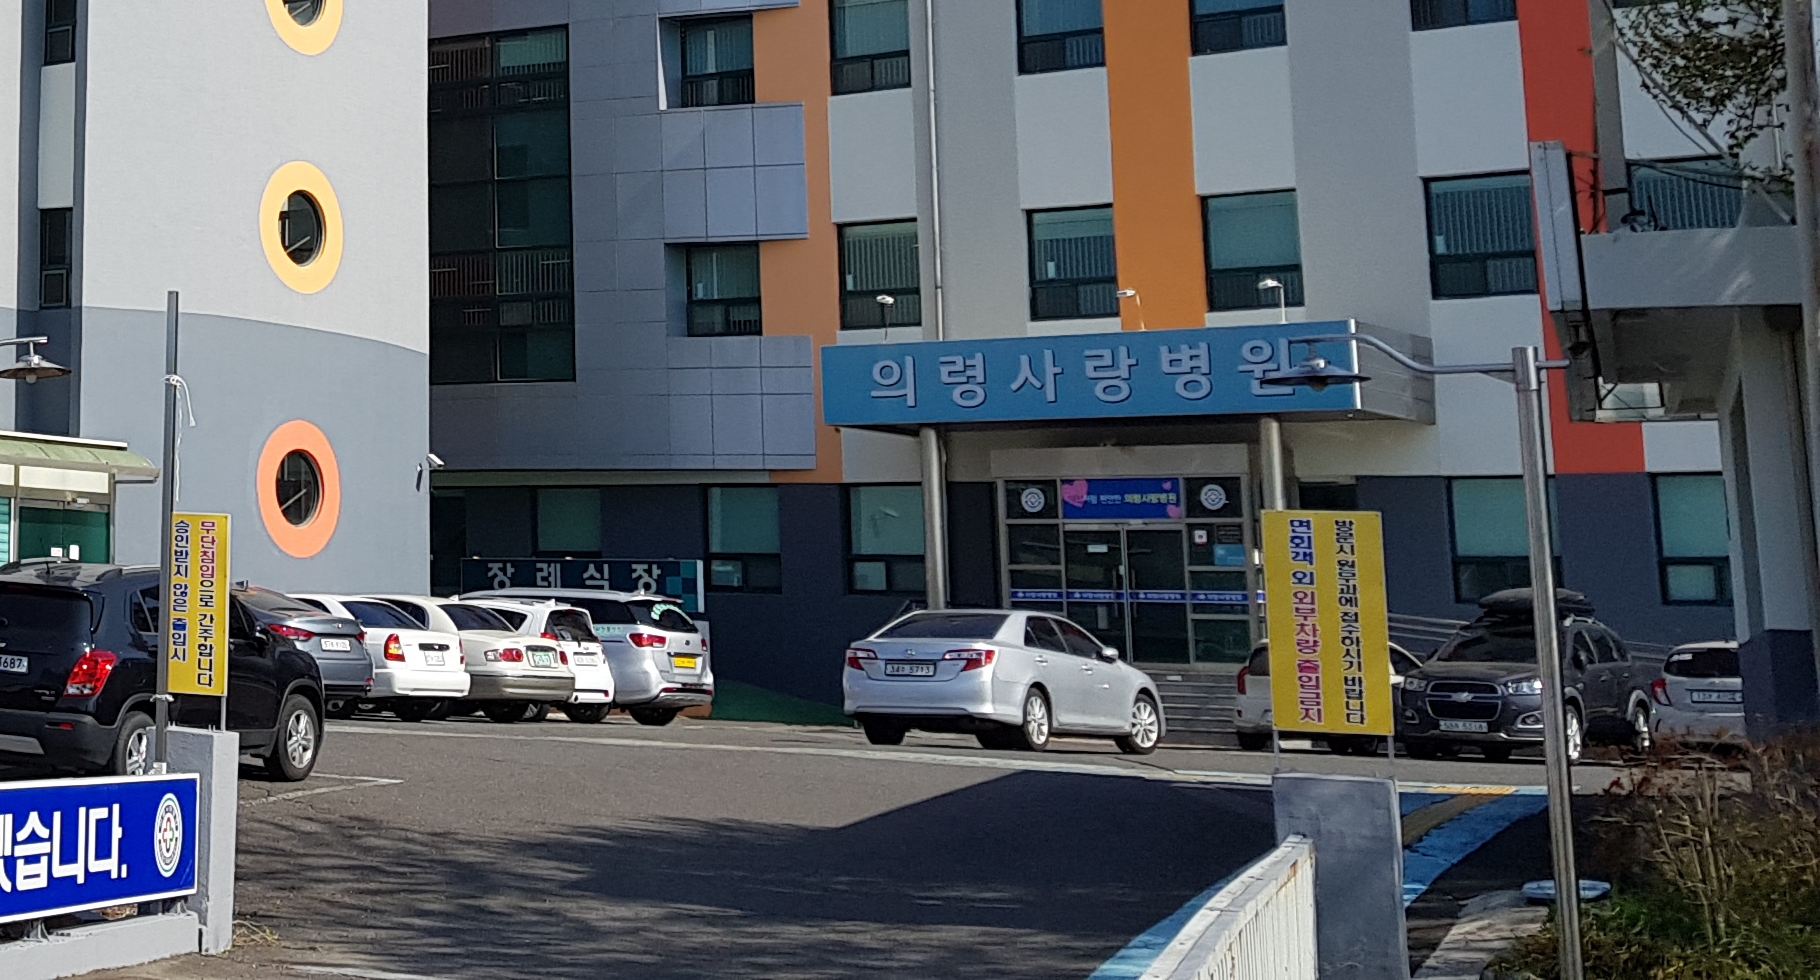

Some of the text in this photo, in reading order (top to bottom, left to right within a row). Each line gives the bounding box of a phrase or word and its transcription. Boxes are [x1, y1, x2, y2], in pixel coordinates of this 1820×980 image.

[870, 338, 1296, 409] 의령사랑병원
[170, 520, 190, 662] 승인받지 않은 출입시
[196, 521, 217, 688] 무단침입으로 간주합니다
[487, 562, 662, 593] 장례식장
[1289, 519, 1323, 724] 면회객 외 외부차량 출입금지
[1334, 520, 1365, 726] 방문시 원무과에 접수하시기 바랍니다
